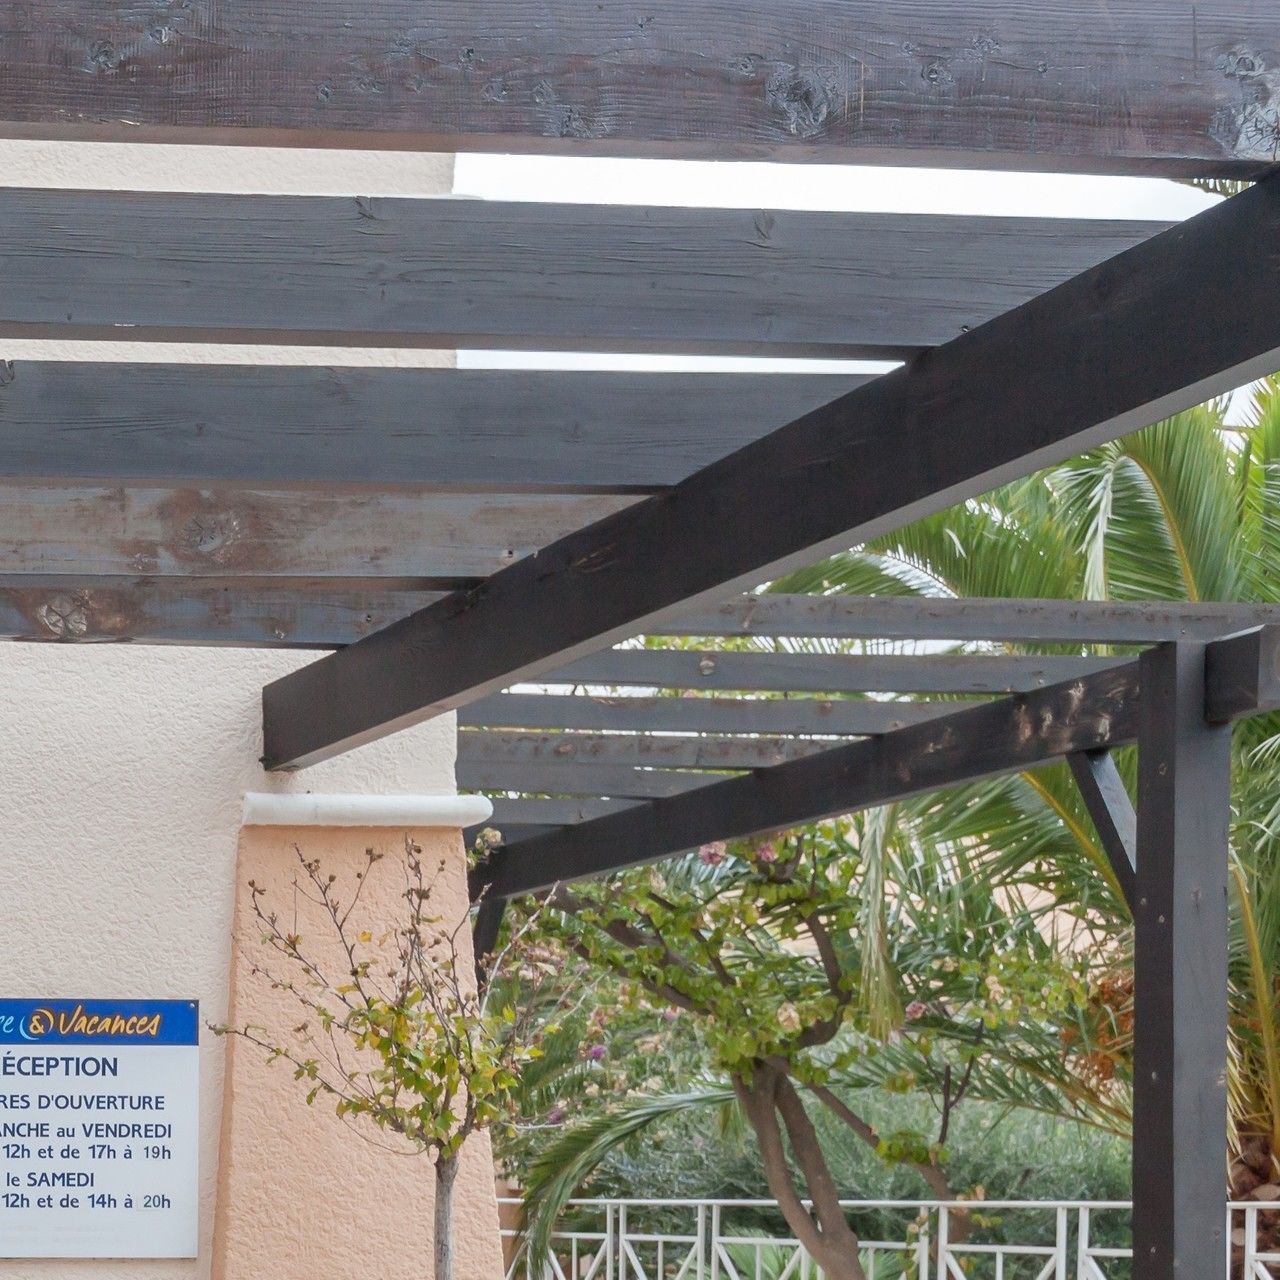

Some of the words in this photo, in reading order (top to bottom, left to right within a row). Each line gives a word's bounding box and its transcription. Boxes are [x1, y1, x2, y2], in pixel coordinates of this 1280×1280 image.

[60, 1004, 160, 1036] Vacances
[38, 1094, 165, 1111] D'OUVERTURE
[56, 1126, 75, 1138] au
[82, 1123, 172, 1139] VENDREDI
[2, 1143, 31, 1159] 12h
[37, 1145, 54, 1159] et
[60, 1144, 80, 1159] de
[88, 1144, 117, 1159] 17h
[123, 1145, 132, 1160] à
[143, 1145, 171, 1160] 19h
[6, 1172, 21, 1187] le
[26, 1172, 94, 1188] SAMEDI
[1, 1193, 30, 1209] 12h
[37, 1194, 54, 1209] et
[59, 1193, 80, 1209] de
[87, 1193, 117, 1209] 14h
[124, 1194, 133, 1209] à
[143, 1194, 171, 1209] 20h
